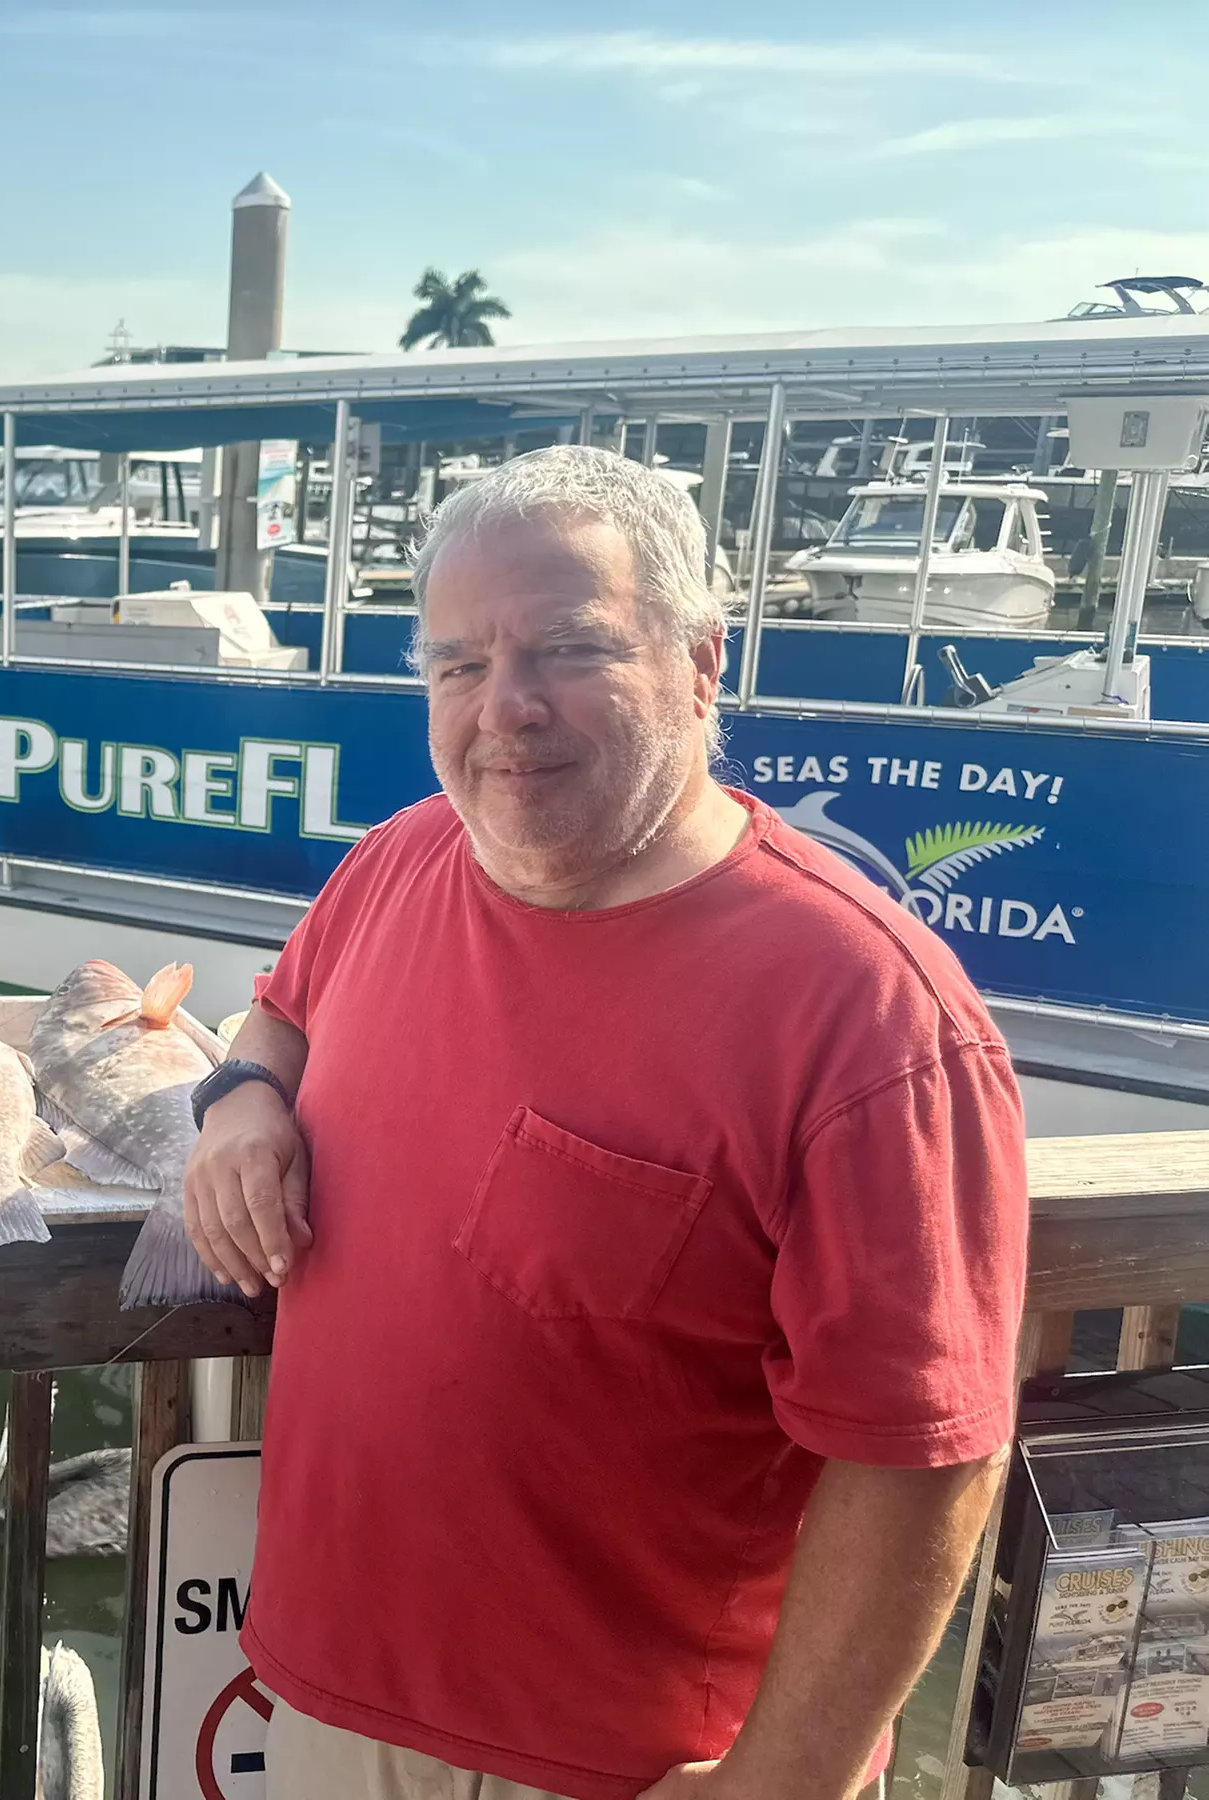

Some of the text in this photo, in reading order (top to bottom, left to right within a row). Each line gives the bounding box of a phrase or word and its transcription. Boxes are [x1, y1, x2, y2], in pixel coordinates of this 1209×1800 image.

[753, 755, 1064, 805] SEAS THE DAY!
[1054, 1567, 1135, 1593] CRUISES
